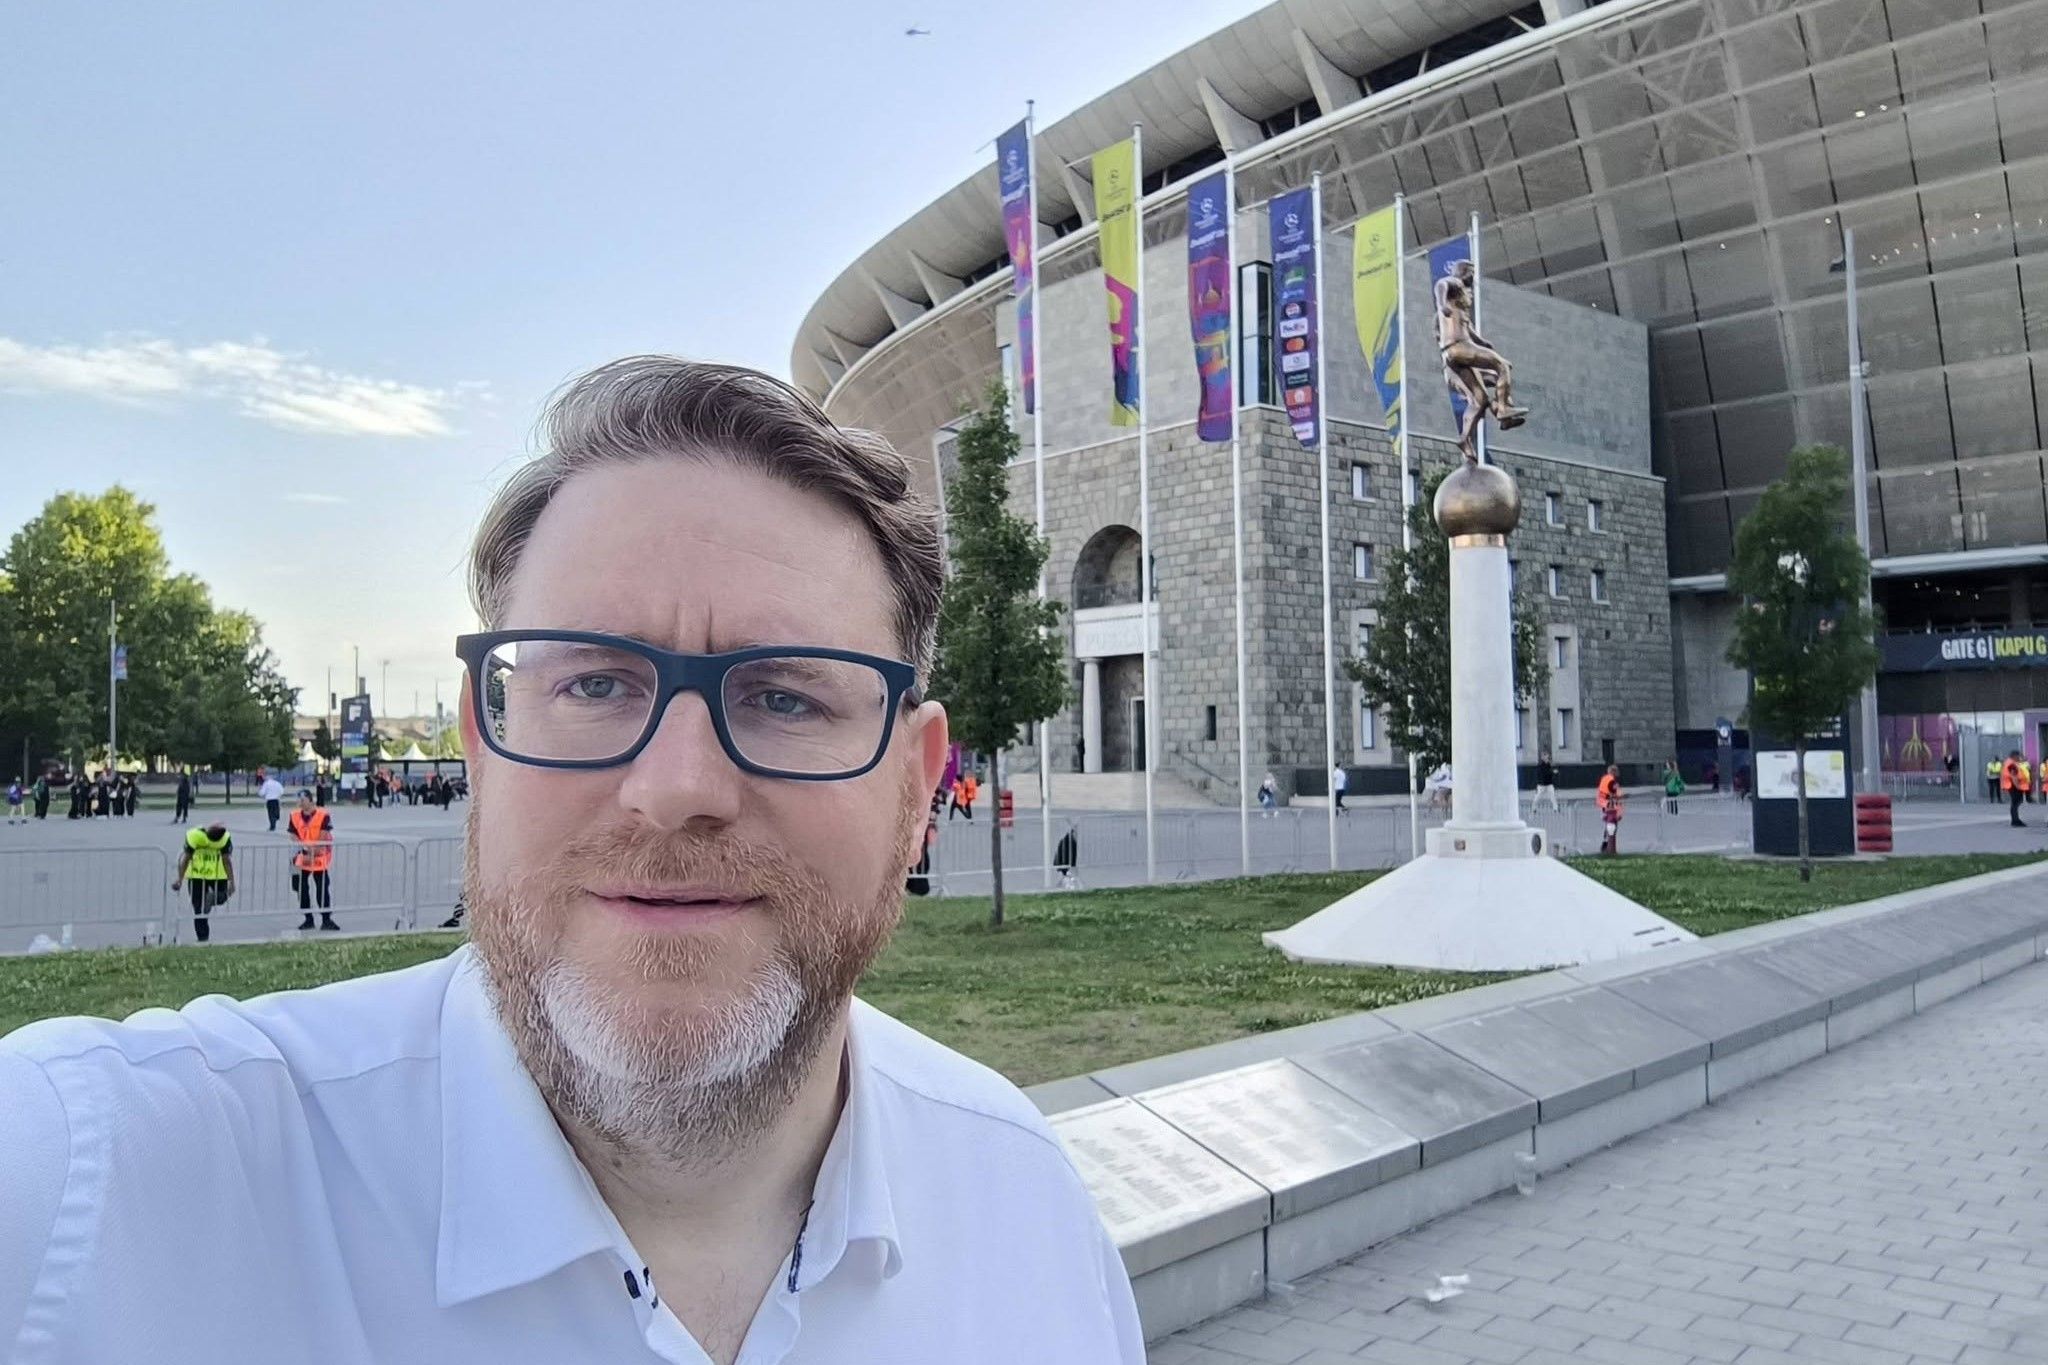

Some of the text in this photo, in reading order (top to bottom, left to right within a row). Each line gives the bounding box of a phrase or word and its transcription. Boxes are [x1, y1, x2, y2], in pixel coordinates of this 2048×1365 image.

[1941, 638, 1976, 660] GATE
[1976, 637, 1987, 658] G
[1995, 636, 2034, 656] KAPU
[2036, 635, 2047, 655] G
[349, 704, 362, 721] F
